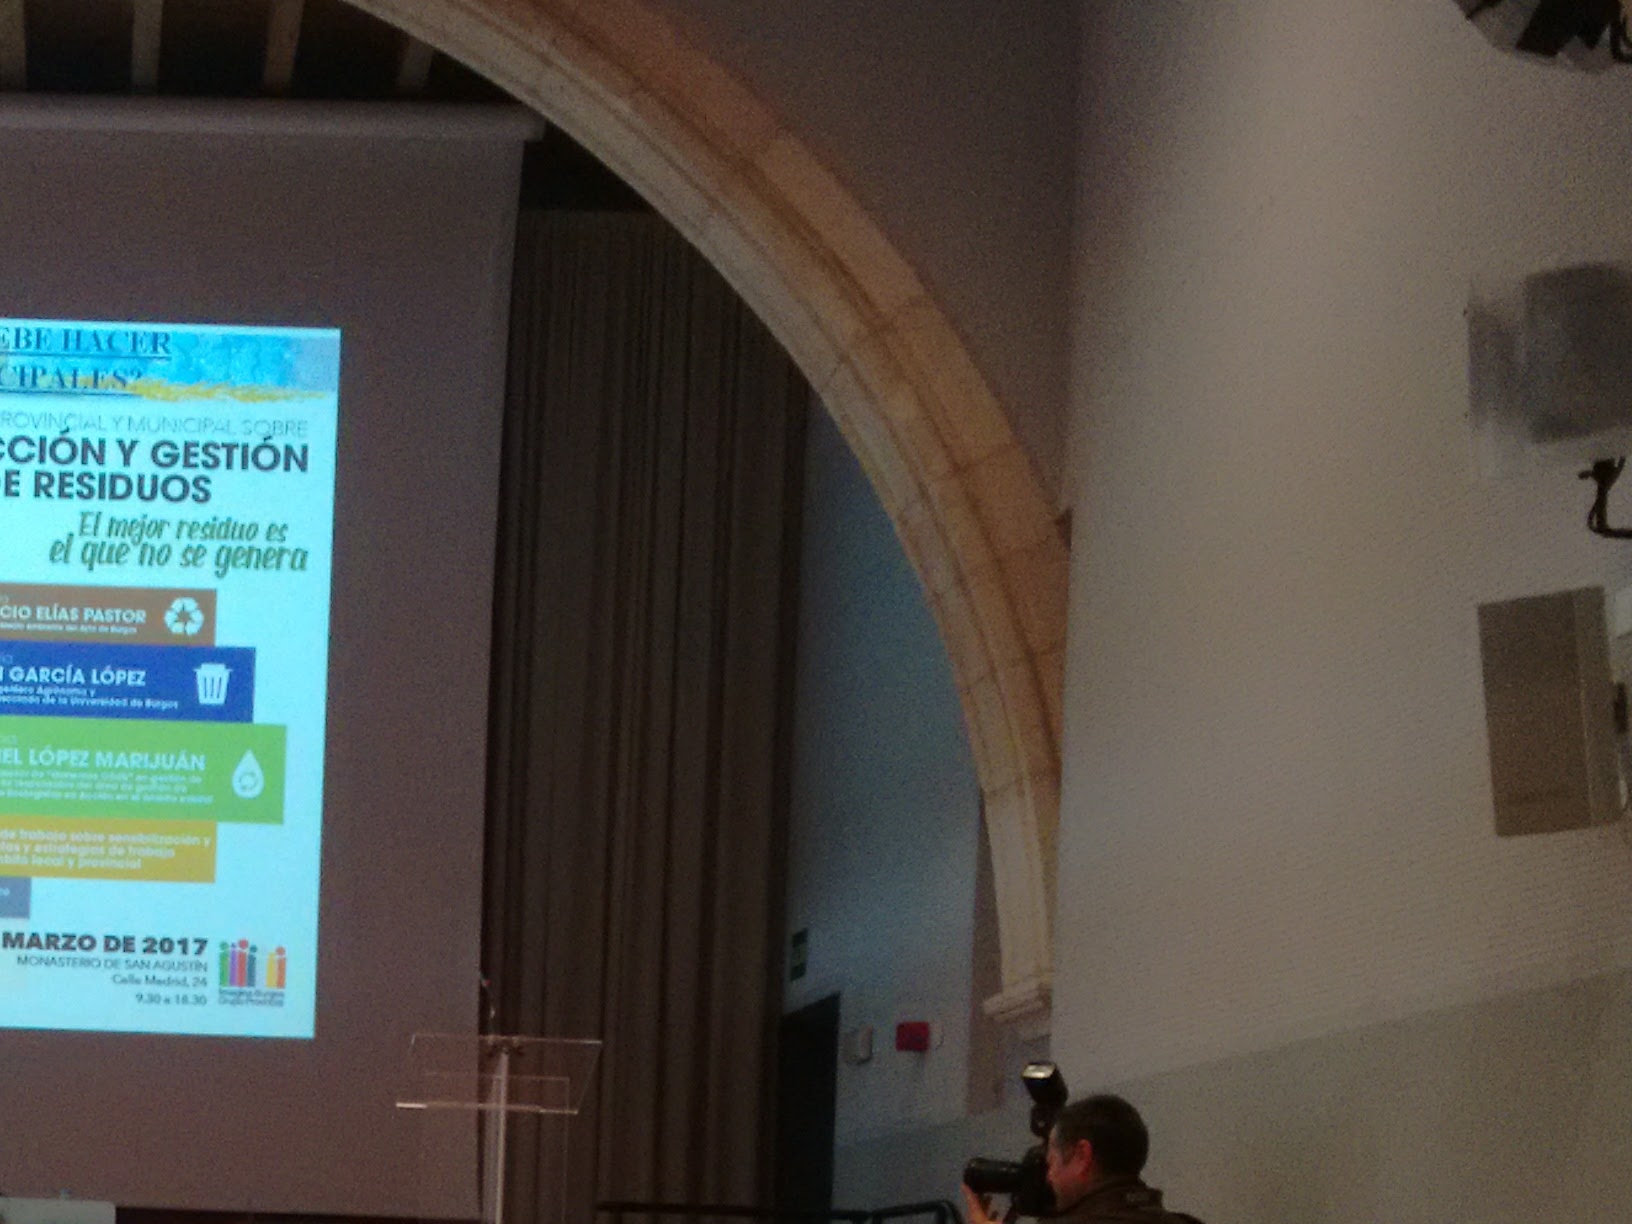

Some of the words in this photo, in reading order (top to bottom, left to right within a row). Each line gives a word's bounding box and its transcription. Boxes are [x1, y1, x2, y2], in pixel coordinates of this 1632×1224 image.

[63, 329, 171, 353] HACER
[113, 416, 123, 431] Y
[128, 416, 235, 435] MUNICIPAL
[243, 419, 308, 437] SOBRE
[116, 440, 139, 467] Y
[151, 435, 308, 472] GESTIÓN
[34, 469, 212, 504] RESIDUOS
[79, 510, 102, 536] El
[107, 514, 169, 546] mejor
[176, 516, 259, 541] residuo
[265, 523, 288, 542] es
[49, 532, 74, 564] el
[80, 540, 130, 571] que
[138, 541, 172, 566] no
[180, 543, 207, 567] se
[215, 544, 308, 578] genera
[36, 604, 79, 621] ELÍAS
[83, 607, 146, 623] PASTOR
[9, 664, 85, 684] GARCÍA
[92, 665, 146, 686] LÓPEZ
[29, 745, 89, 768] LÓPEZ
[95, 749, 206, 771] MARIJUÁN
[2, 931, 97, 951] MARZO
[103, 935, 136, 953] DE
[142, 937, 209, 955] 2017
[17, 956, 101, 969] MONASTERIO
[104, 959, 120, 970] DE
[125, 959, 150, 971] SAN
